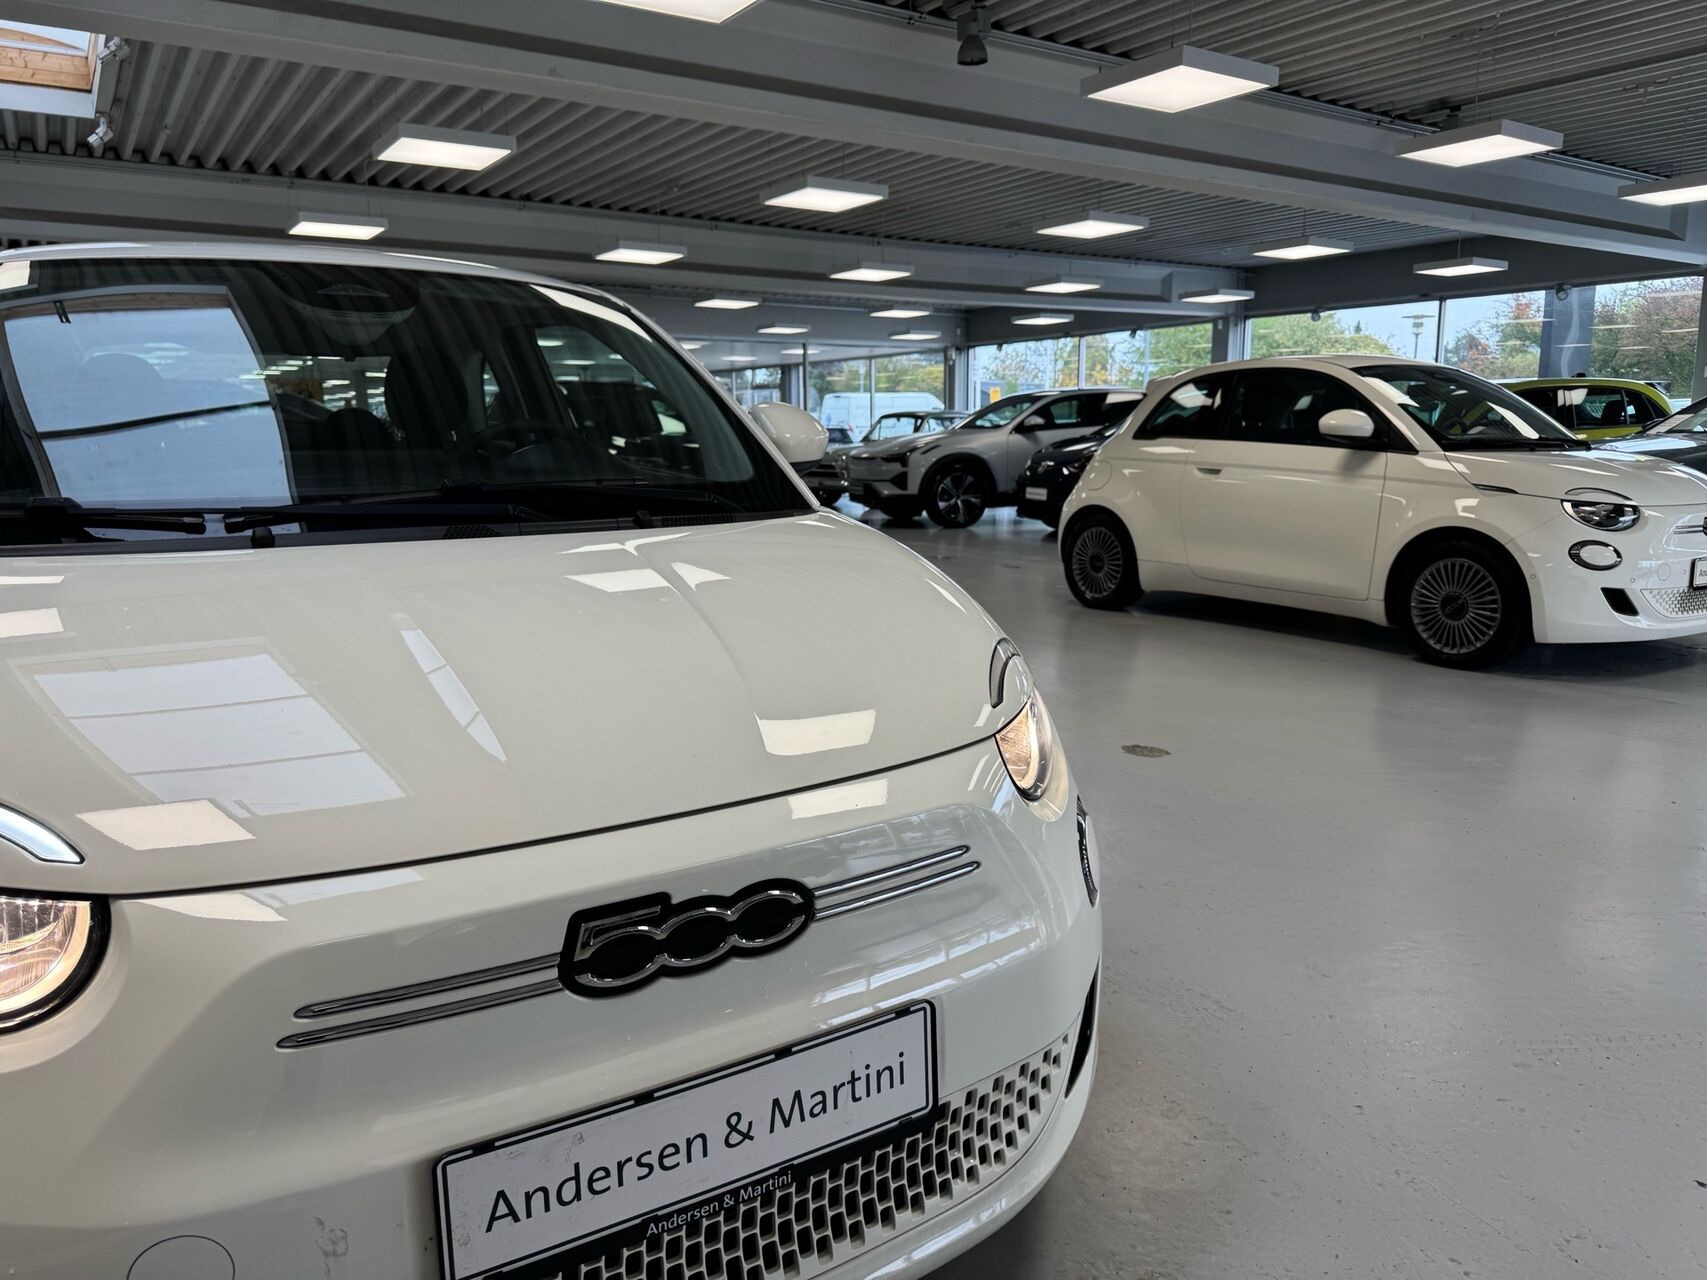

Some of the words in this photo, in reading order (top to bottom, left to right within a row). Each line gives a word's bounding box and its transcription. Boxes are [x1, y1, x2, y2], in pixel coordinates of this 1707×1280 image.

[571, 886, 806, 989] 500
[485, 1132, 709, 1233] Andersen
[723, 1111, 755, 1149] &
[769, 1051, 905, 1134] Martini
[646, 1201, 719, 1237] Andersen
[723, 1194, 735, 1208] &
[739, 1170, 792, 1202] Martini
